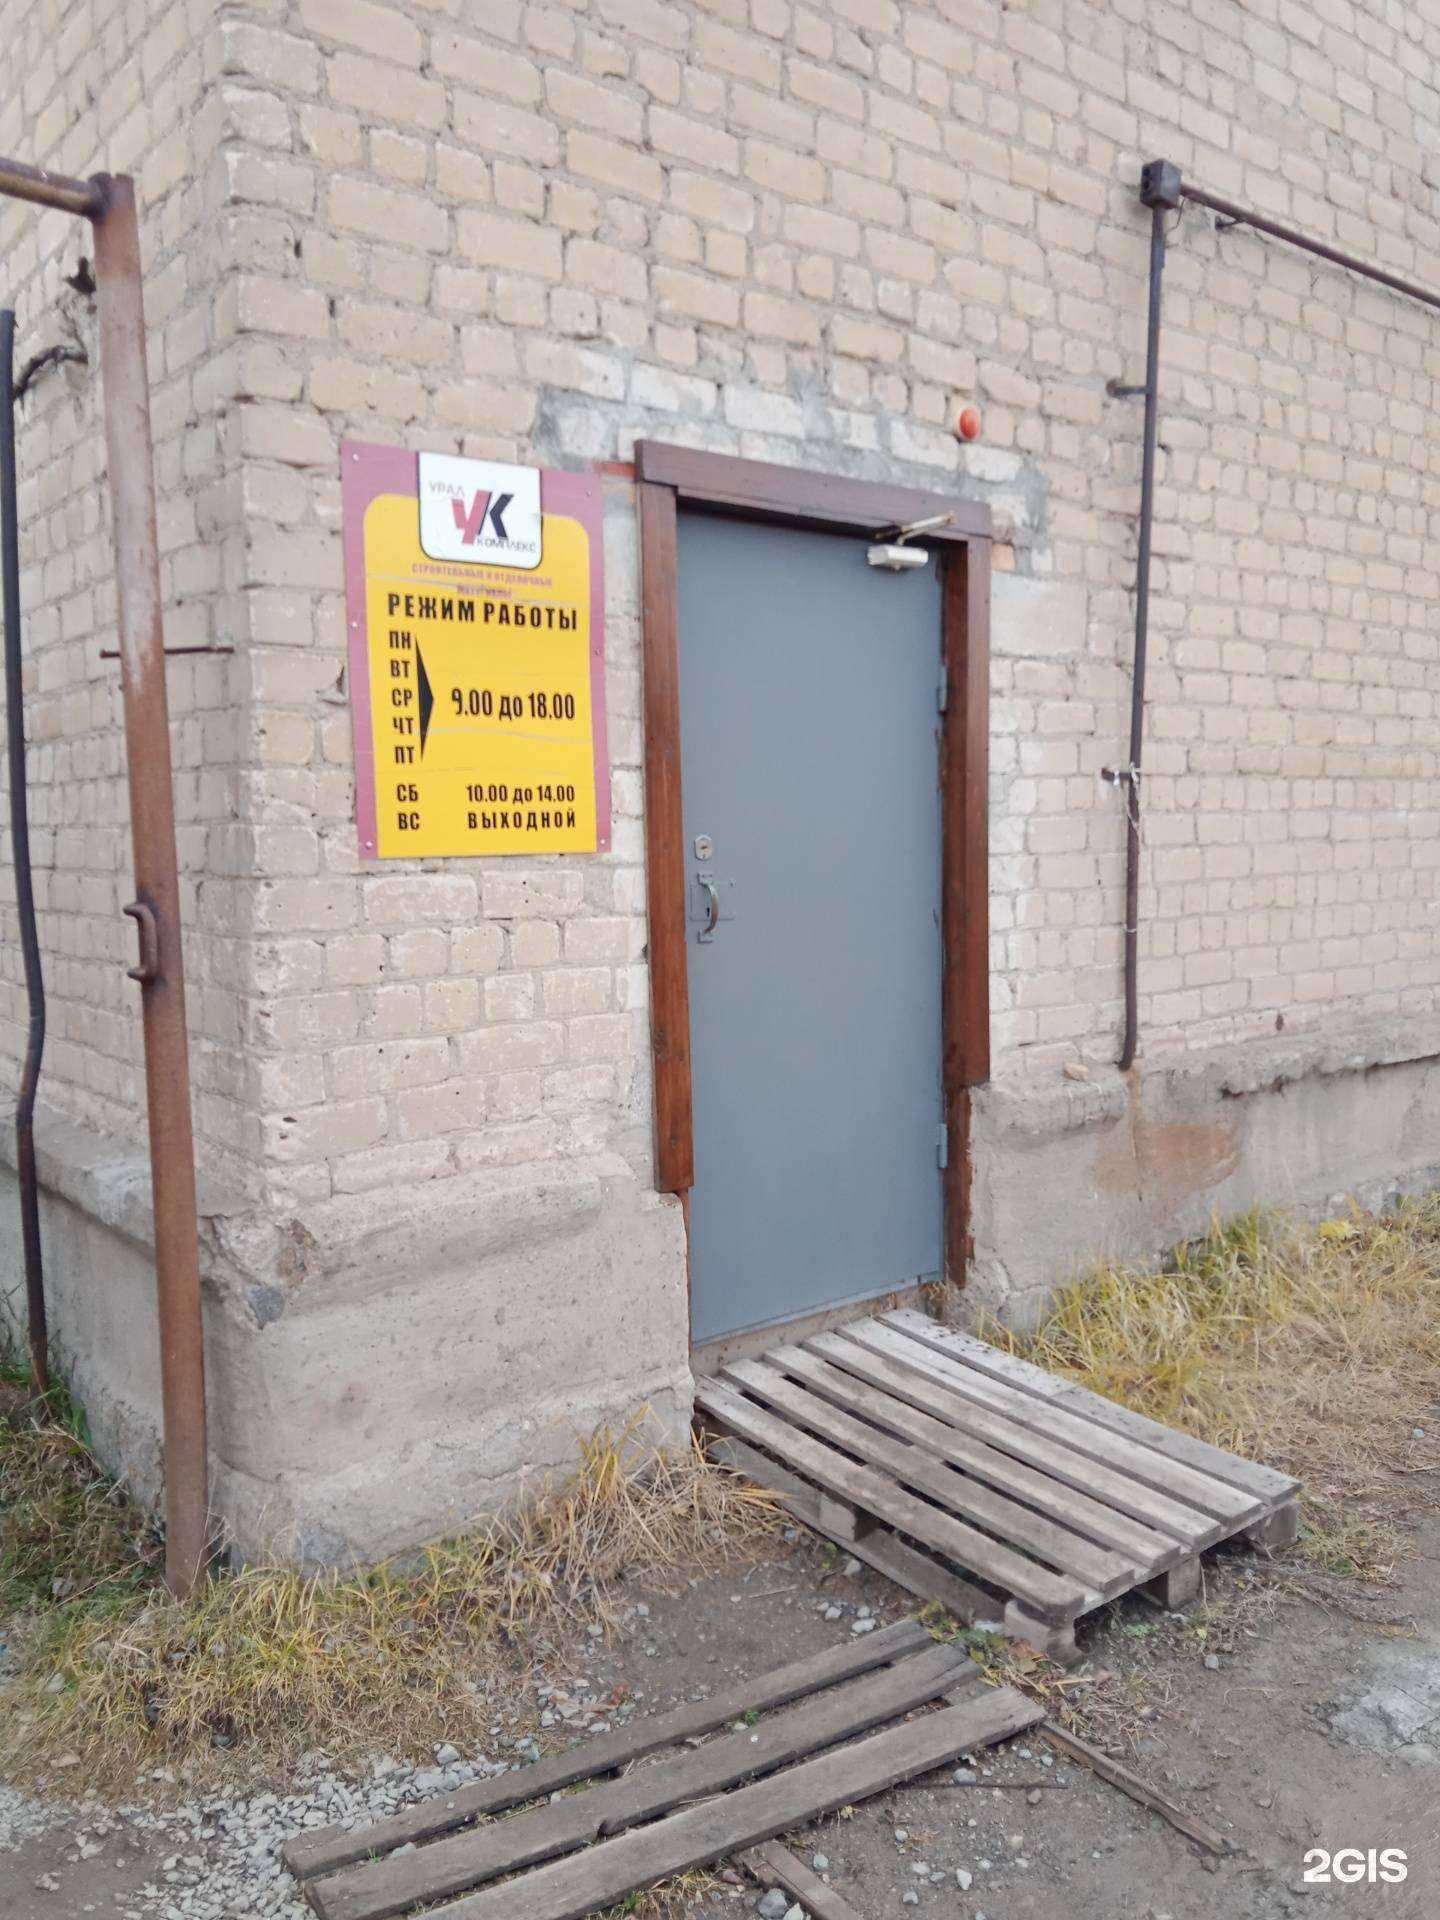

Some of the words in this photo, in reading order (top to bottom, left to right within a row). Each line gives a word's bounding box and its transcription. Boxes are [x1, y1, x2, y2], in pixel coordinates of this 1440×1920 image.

[388, 594, 475, 622] РЕЖИМ
[483, 602, 577, 630] РАБОТЫ
[389, 631, 411, 649] ПН
[390, 660, 410, 678] ВТ
[391, 688, 412, 707] СР
[451, 688, 493, 716] 9.00
[499, 696, 523, 720] до
[528, 693, 575, 719] 18.00
[393, 717, 413, 735] ЧТ
[395, 746, 414, 764] ПТ
[396, 783, 419, 802] СБ
[467, 785, 507, 802] 10.00
[512, 791, 533, 805] до
[537, 785, 575, 802] 14.00
[398, 812, 420, 830] ВС
[468, 808, 576, 831] ВЫХОДНОЙ
